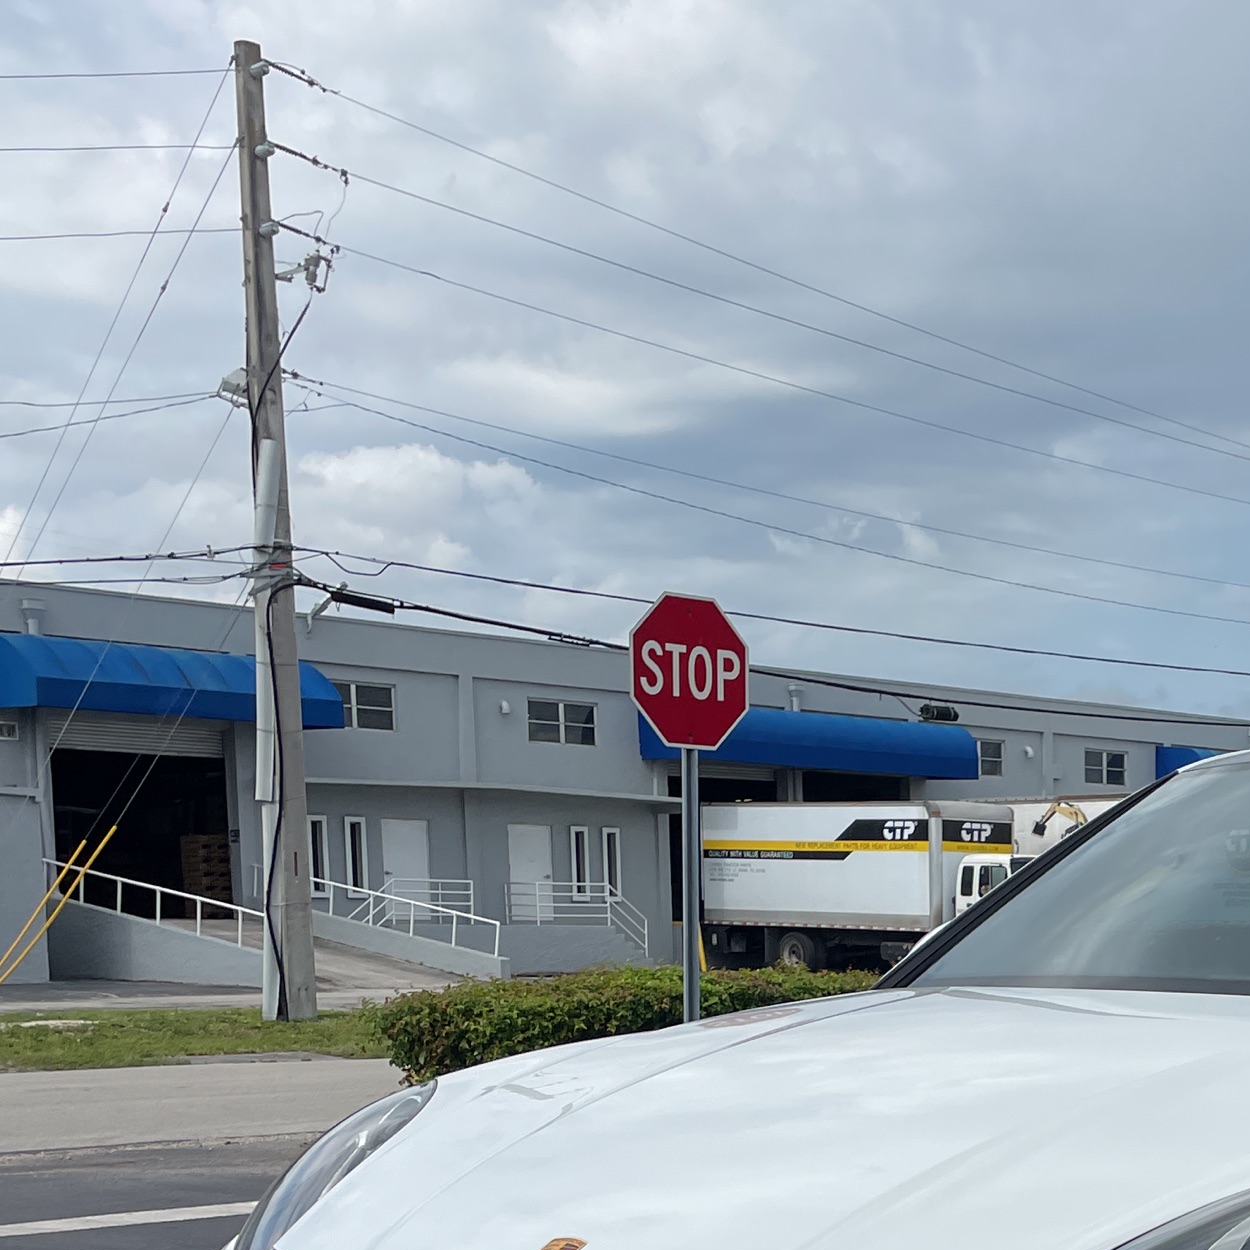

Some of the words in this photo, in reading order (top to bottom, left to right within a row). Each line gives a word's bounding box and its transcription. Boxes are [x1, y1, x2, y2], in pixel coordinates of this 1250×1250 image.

[639, 639, 741, 702] STOP
[882, 820, 917, 841] CTP
[960, 821, 992, 842] CTP
[743, 850, 759, 858] VALUE
[760, 851, 794, 859] GUARANTEED
